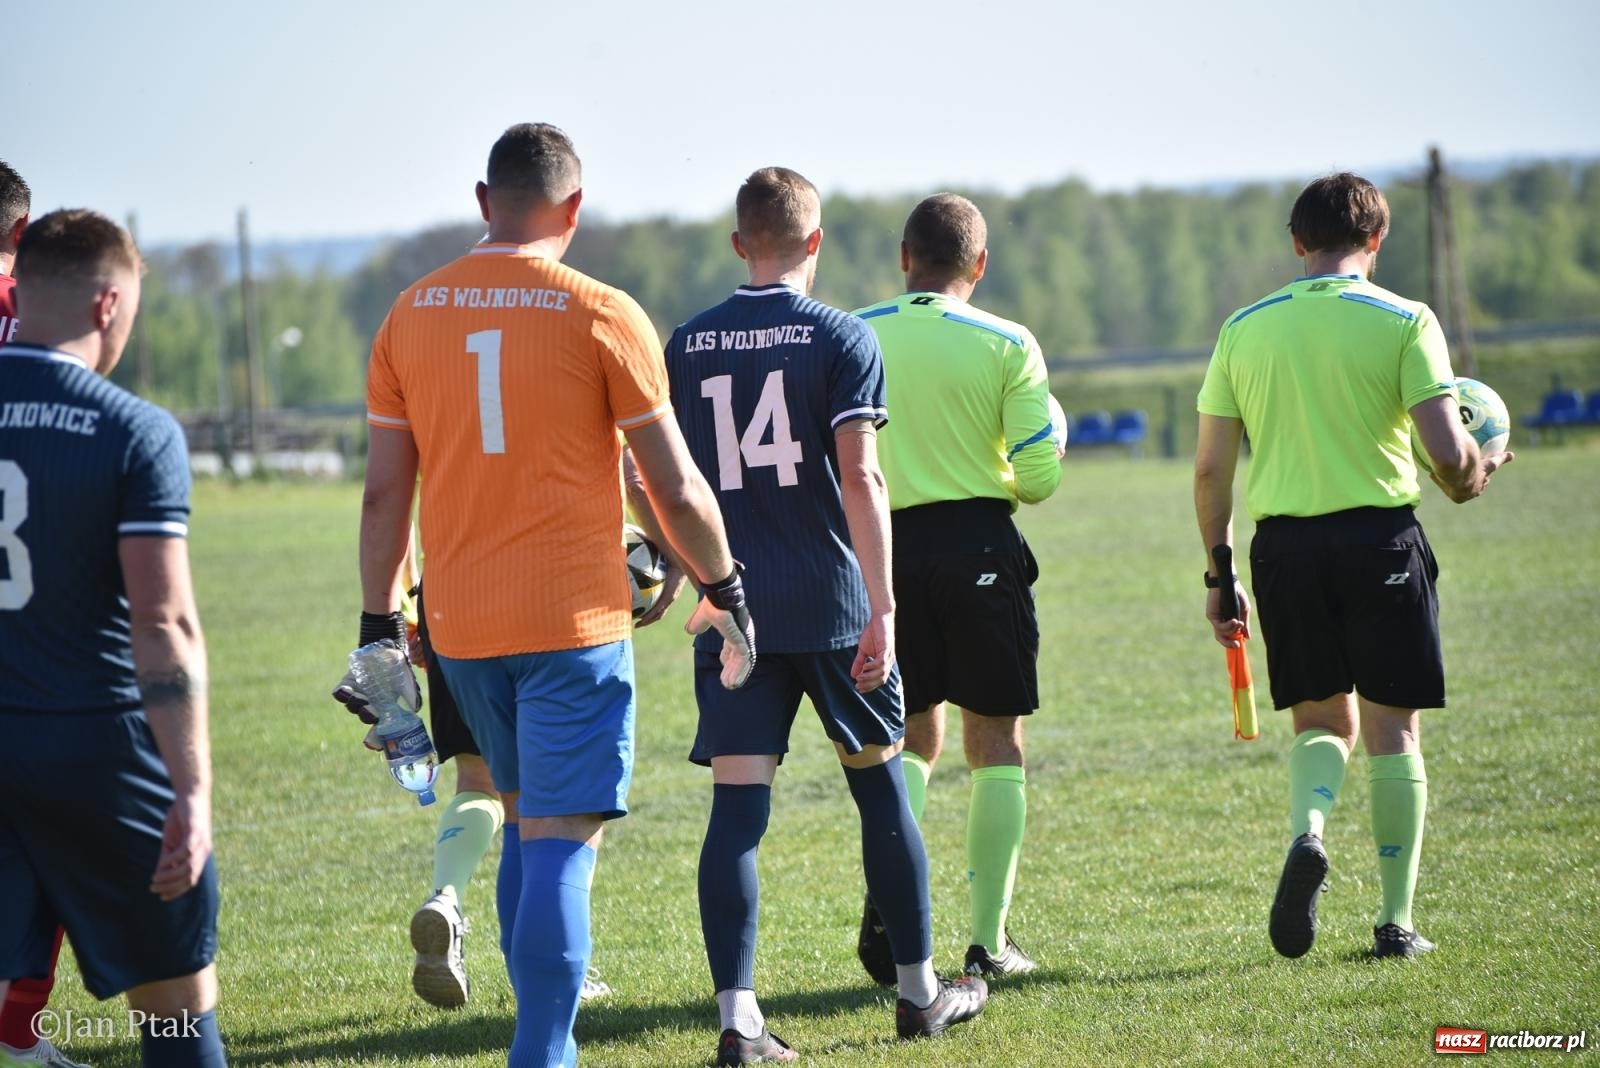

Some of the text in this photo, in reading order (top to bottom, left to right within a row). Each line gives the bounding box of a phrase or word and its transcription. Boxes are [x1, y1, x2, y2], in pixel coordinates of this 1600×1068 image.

[413, 287, 570, 311] LKS WOJNOWICE
[685, 325, 815, 353] LKS WOJNOWICE
[465, 329, 506, 454] 1
[700, 369, 803, 491] 14
